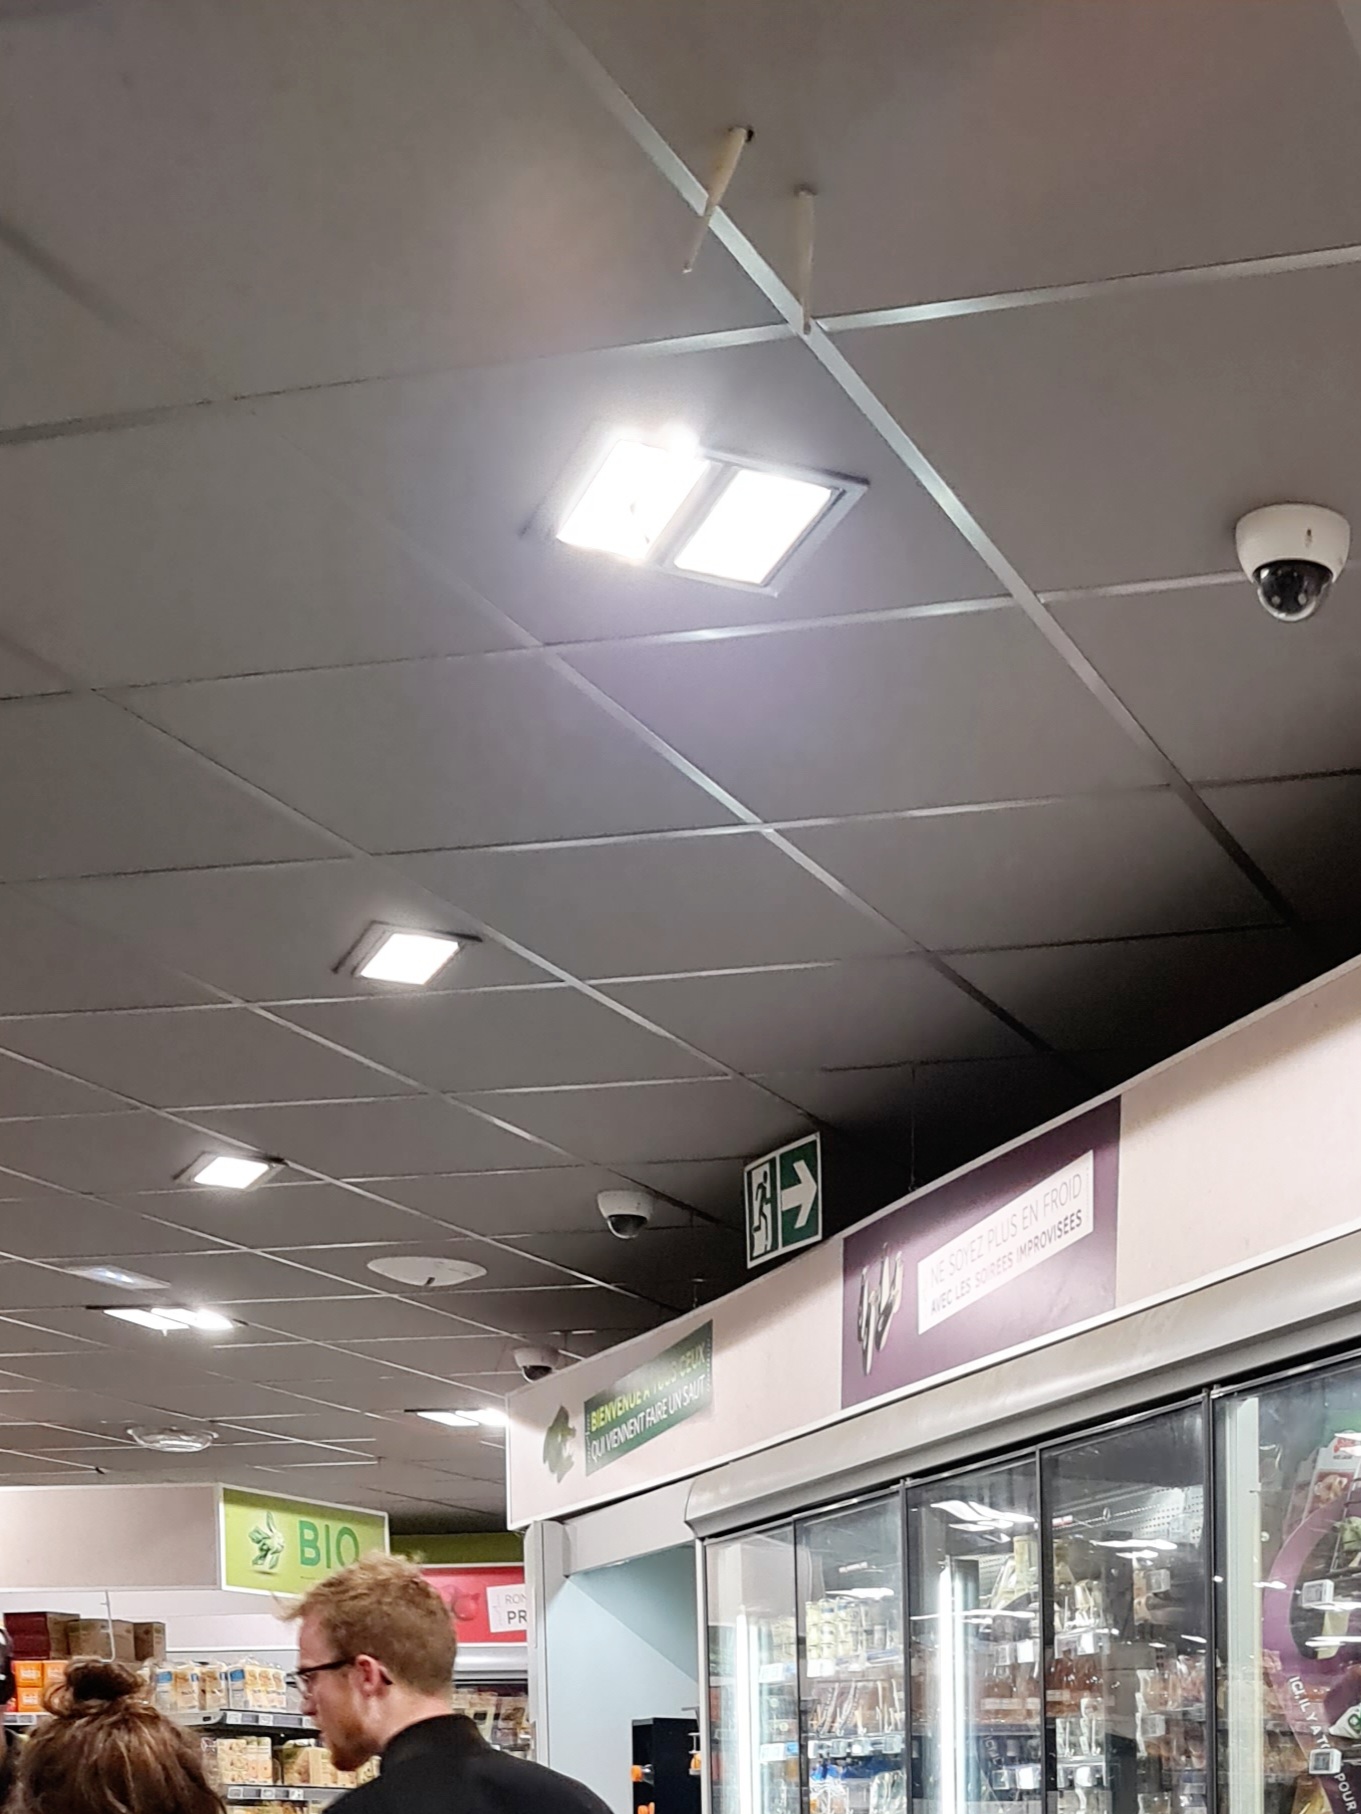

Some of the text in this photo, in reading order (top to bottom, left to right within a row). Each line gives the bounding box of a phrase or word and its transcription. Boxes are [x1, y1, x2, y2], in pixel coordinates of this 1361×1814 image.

[949, 1234, 984, 1277] SOYEZ
[986, 1213, 1018, 1252] PLUS
[1021, 1200, 1039, 1231] EN
[1042, 1173, 1082, 1217] FROID
[955, 1277, 971, 1301] LES
[590, 1390, 643, 1433] BIENVENUE
[590, 1374, 707, 1464] QUI VIENNENT FAIRE UN SAUT
[299, 1519, 360, 1569] BIO
[1310, 1725, 1322, 1736] A
[1334, 1772, 1358, 1812] POUR
